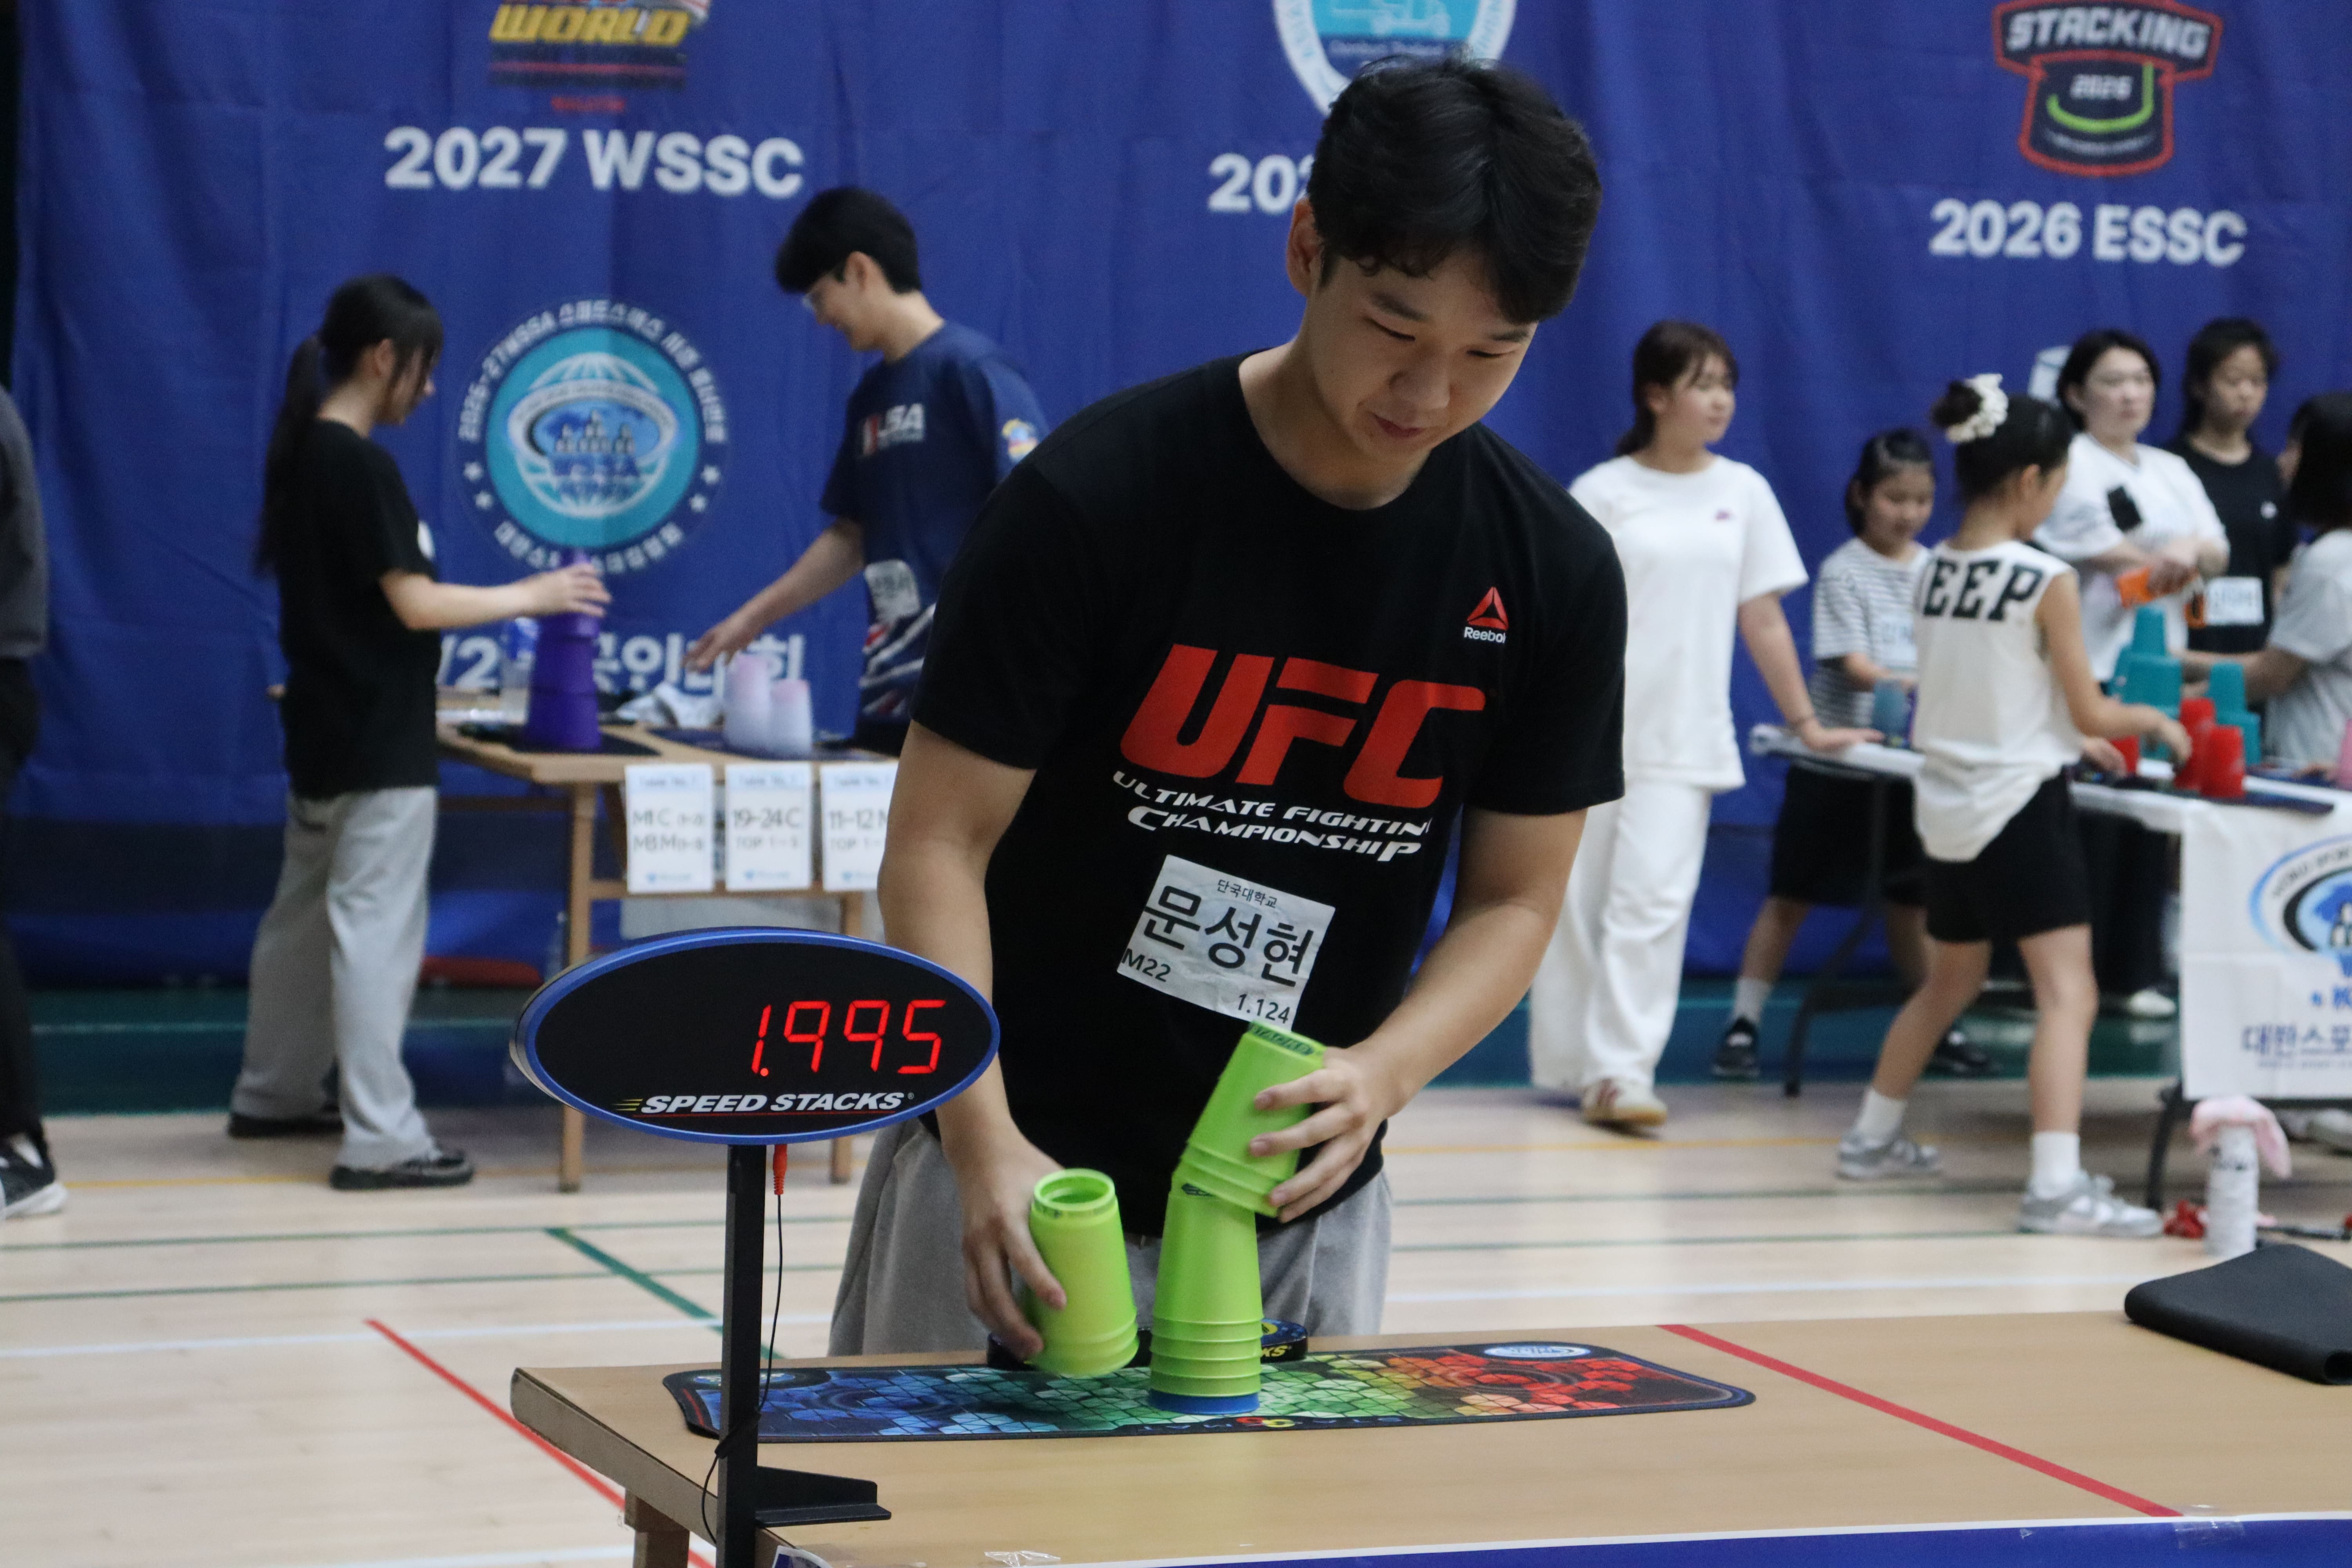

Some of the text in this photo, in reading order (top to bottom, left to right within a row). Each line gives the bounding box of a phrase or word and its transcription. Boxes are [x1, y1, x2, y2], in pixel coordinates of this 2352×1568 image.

[490, 4, 691, 46] WORLD
[2006, 6, 2210, 59] STACKING
[384, 126, 804, 199] 2027 WSSC
[1929, 198, 2247, 266] 2026 ESSC
[1121, 644, 1486, 808] UFC
[1112, 770, 1432, 836] ULTIMATE FIGHTIN
[1127, 806, 1422, 862] CHAMPIONSHIP
[1217, 878, 1278, 909] 단국대학교
[1143, 885, 1314, 988] 문성현
[1121, 948, 1172, 983] M22
[1237, 993, 1291, 1024] 1.124
[751, 1000, 946, 1076] 1.995
[641, 1093, 768, 1114] SPEED
